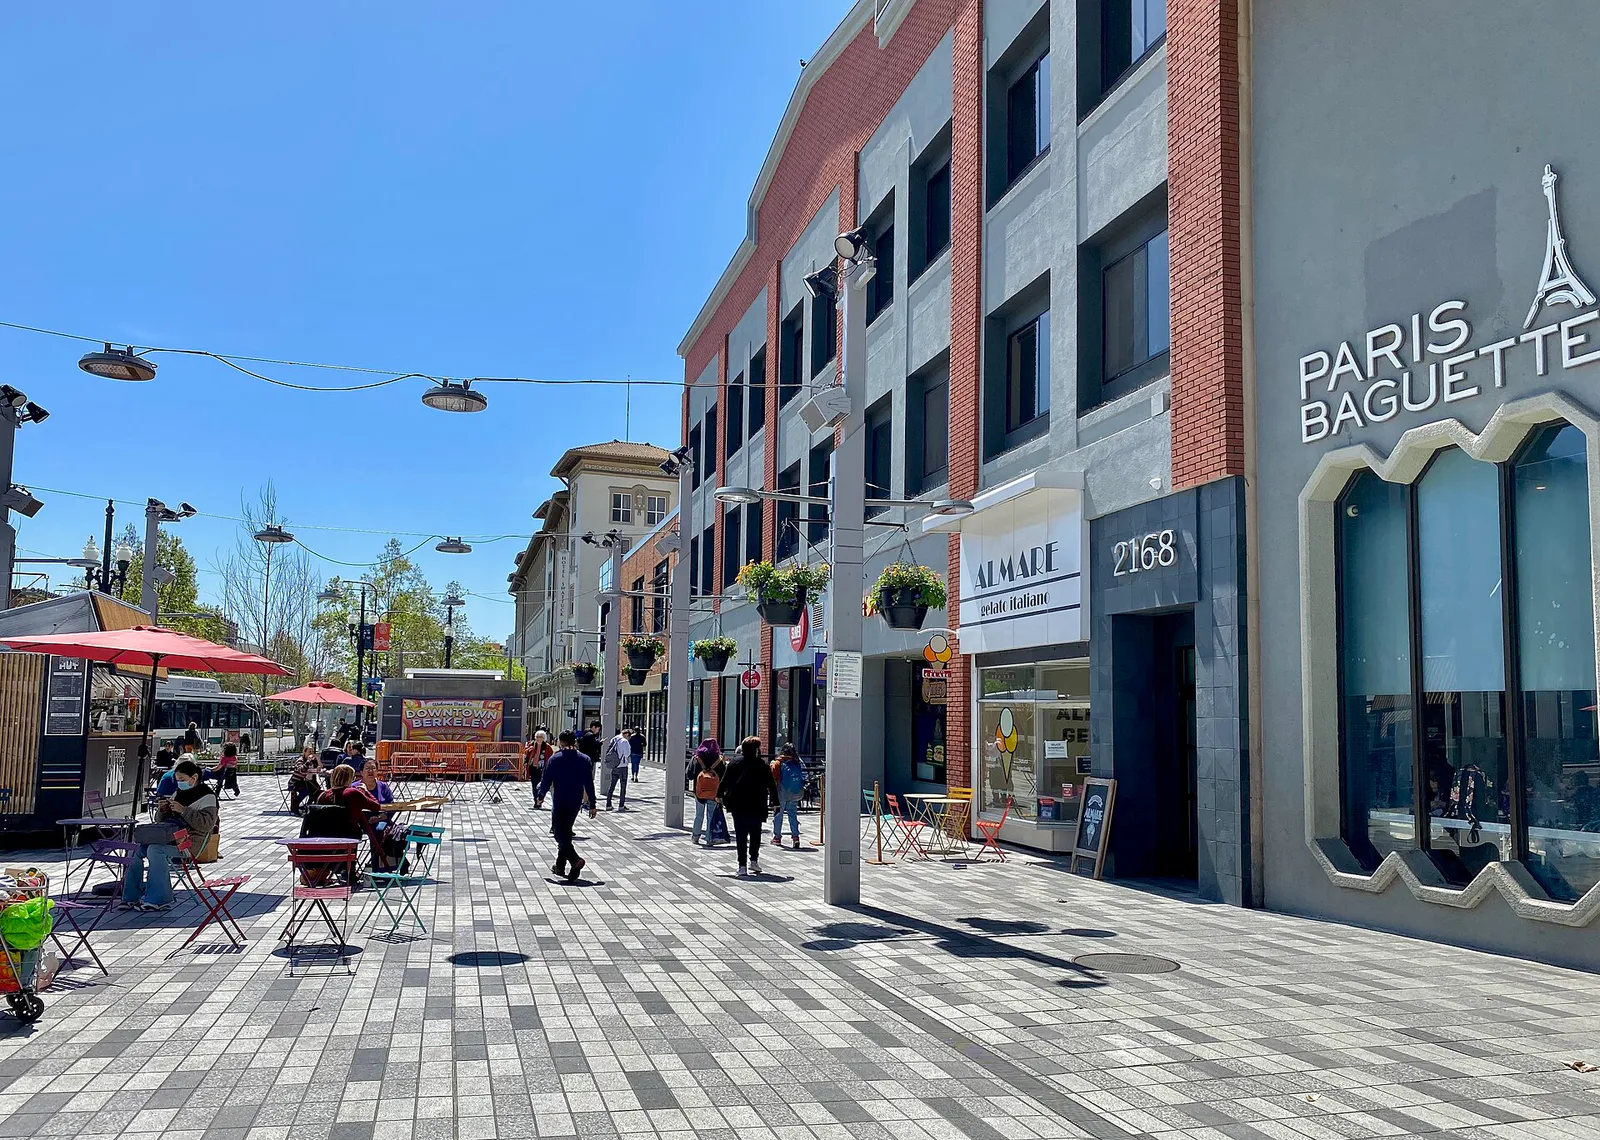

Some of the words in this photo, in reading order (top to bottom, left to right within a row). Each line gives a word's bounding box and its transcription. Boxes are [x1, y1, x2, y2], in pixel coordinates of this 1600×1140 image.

[1300, 300, 1470, 400] PARIS
[1301, 310, 1600, 443] BAGUETTE
[974, 541, 1059, 591] ALMARE
[1113, 530, 1175, 577] 2168
[980, 600, 1007, 617] gelato
[1010, 592, 1050, 611] italiano
[59, 660, 79, 670] HUT
[405, 708, 498, 720] DOWNTOWN
[412, 717, 491, 729] BERKELEY
